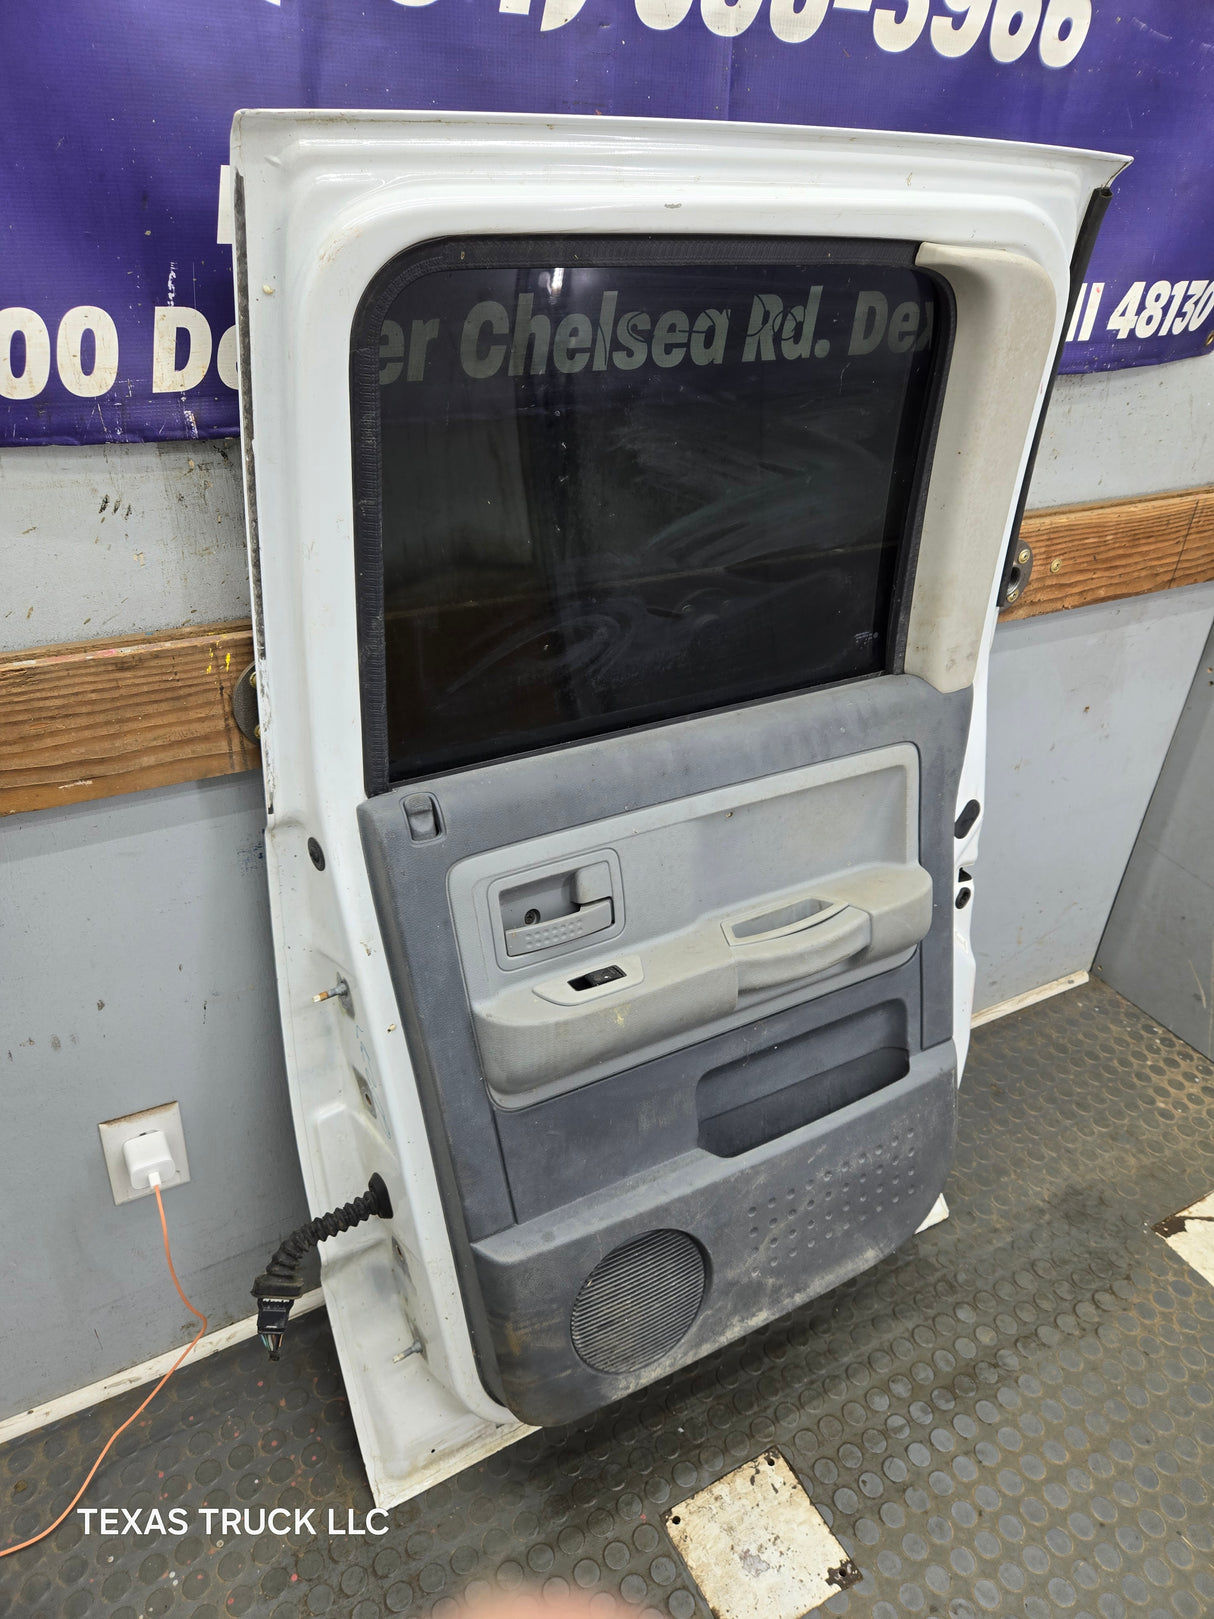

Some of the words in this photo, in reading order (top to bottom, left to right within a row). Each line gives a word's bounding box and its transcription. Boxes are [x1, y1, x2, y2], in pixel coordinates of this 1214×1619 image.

[459, 290, 731, 379] Chelsea
[741, 285, 831, 363] Rd.
[1106, 280, 1214, 339] 48130
